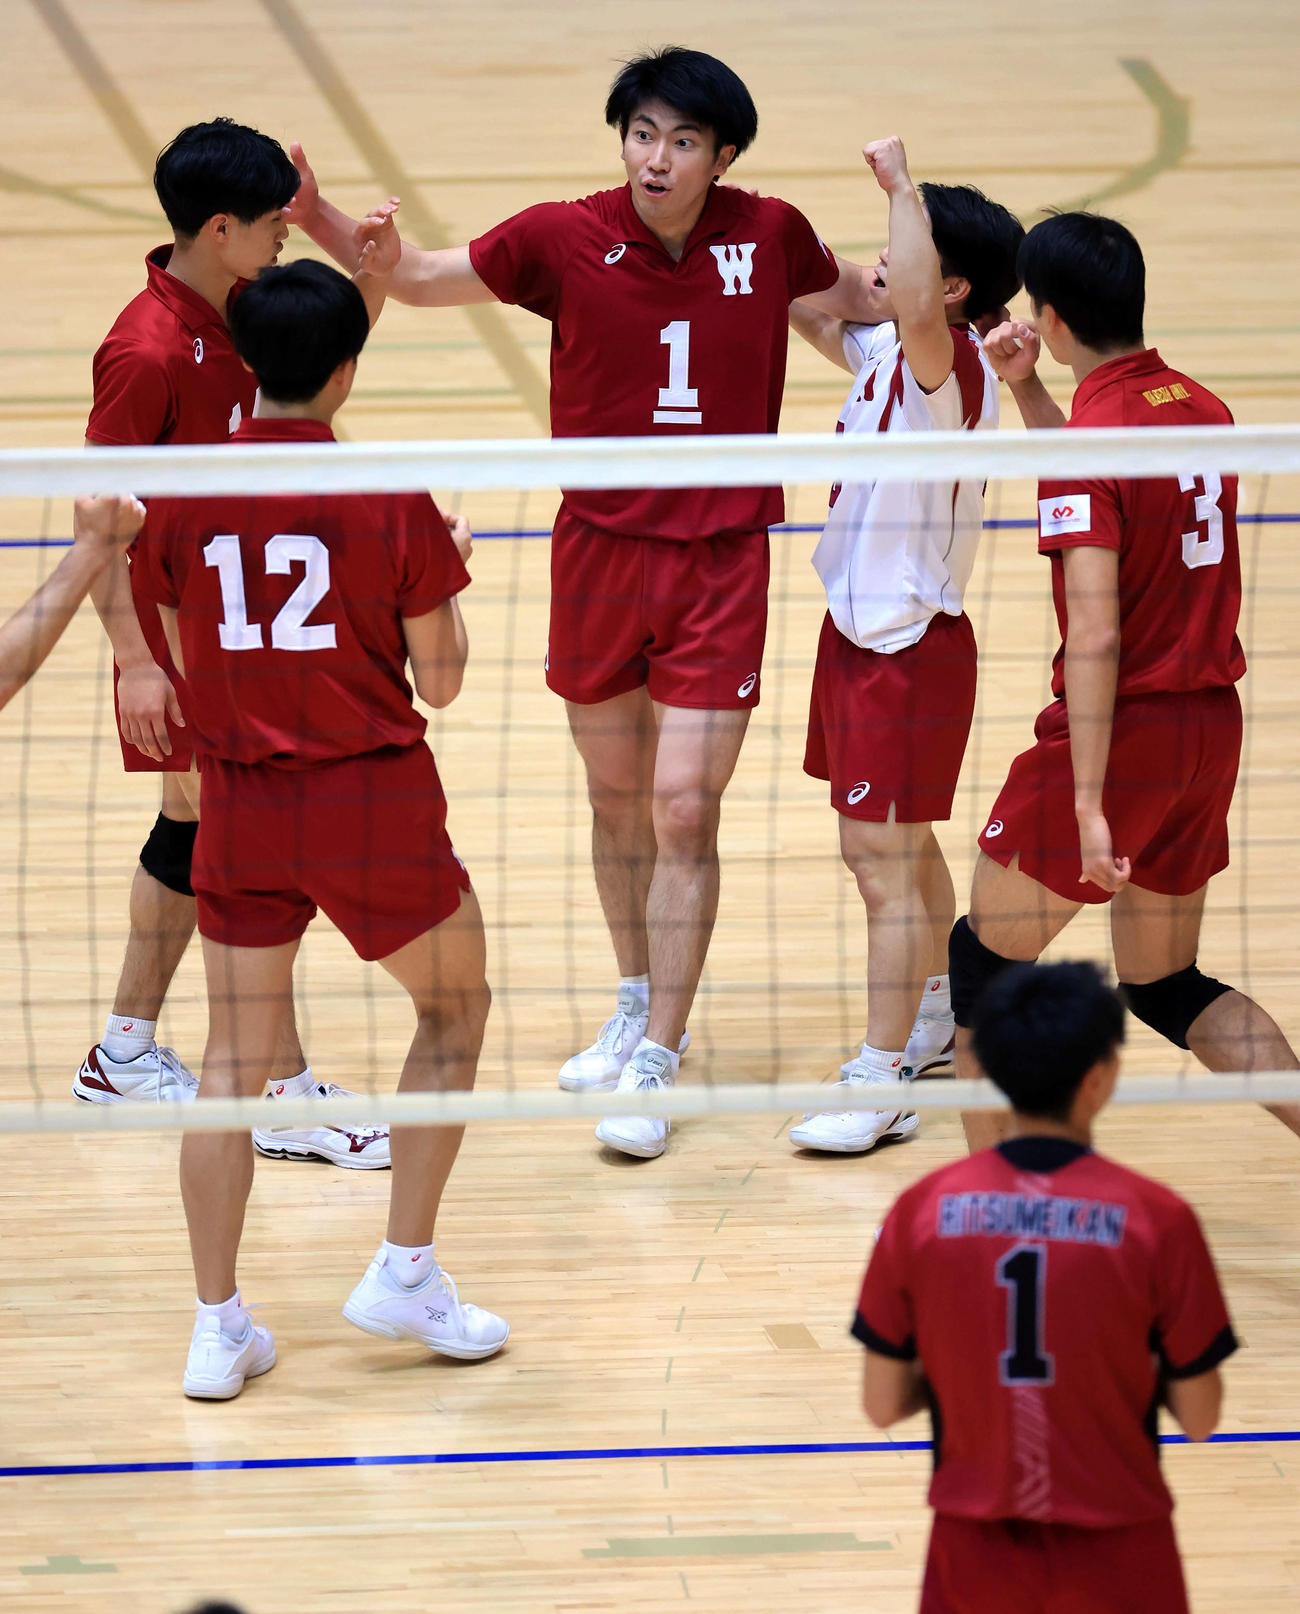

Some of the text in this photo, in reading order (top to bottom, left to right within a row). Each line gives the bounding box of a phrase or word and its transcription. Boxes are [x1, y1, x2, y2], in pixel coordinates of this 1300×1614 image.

[709, 242, 757, 296] W
[658, 320, 699, 408] 1
[1176, 470, 1224, 570] 3
[203, 534, 338, 651] 12
[937, 1190, 1128, 1249] RITSUMEIKAN
[994, 1242, 1056, 1386] 1
